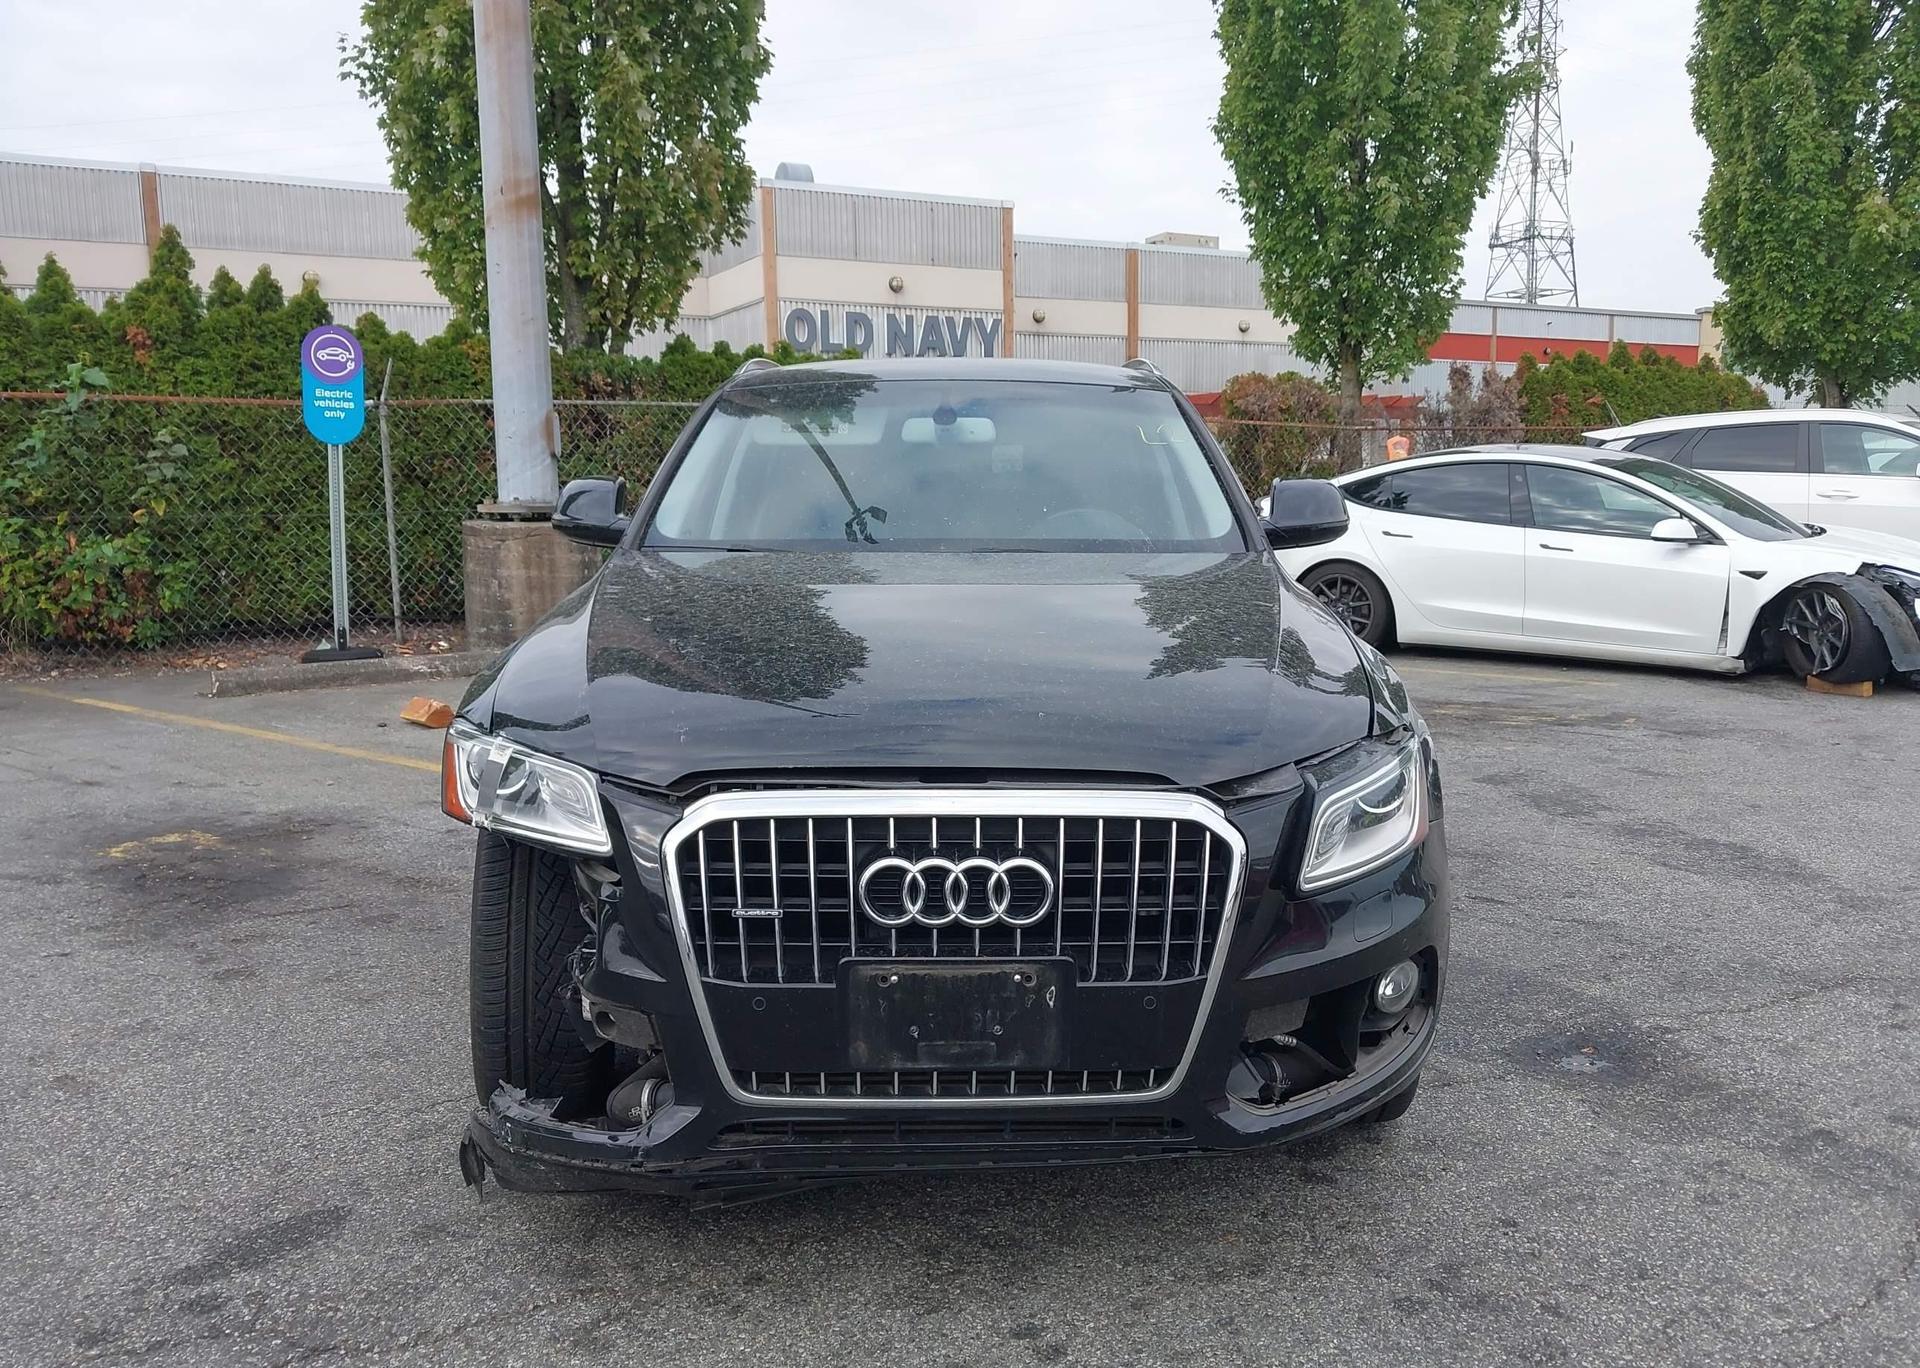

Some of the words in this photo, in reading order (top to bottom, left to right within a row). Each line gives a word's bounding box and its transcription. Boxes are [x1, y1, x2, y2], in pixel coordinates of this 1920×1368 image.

[784, 307, 874, 354] OLD
[885, 312, 1002, 358] NAVY
[315, 388, 353, 399] Electric
[314, 399, 355, 409] vehicles
[324, 410, 345, 420] only
